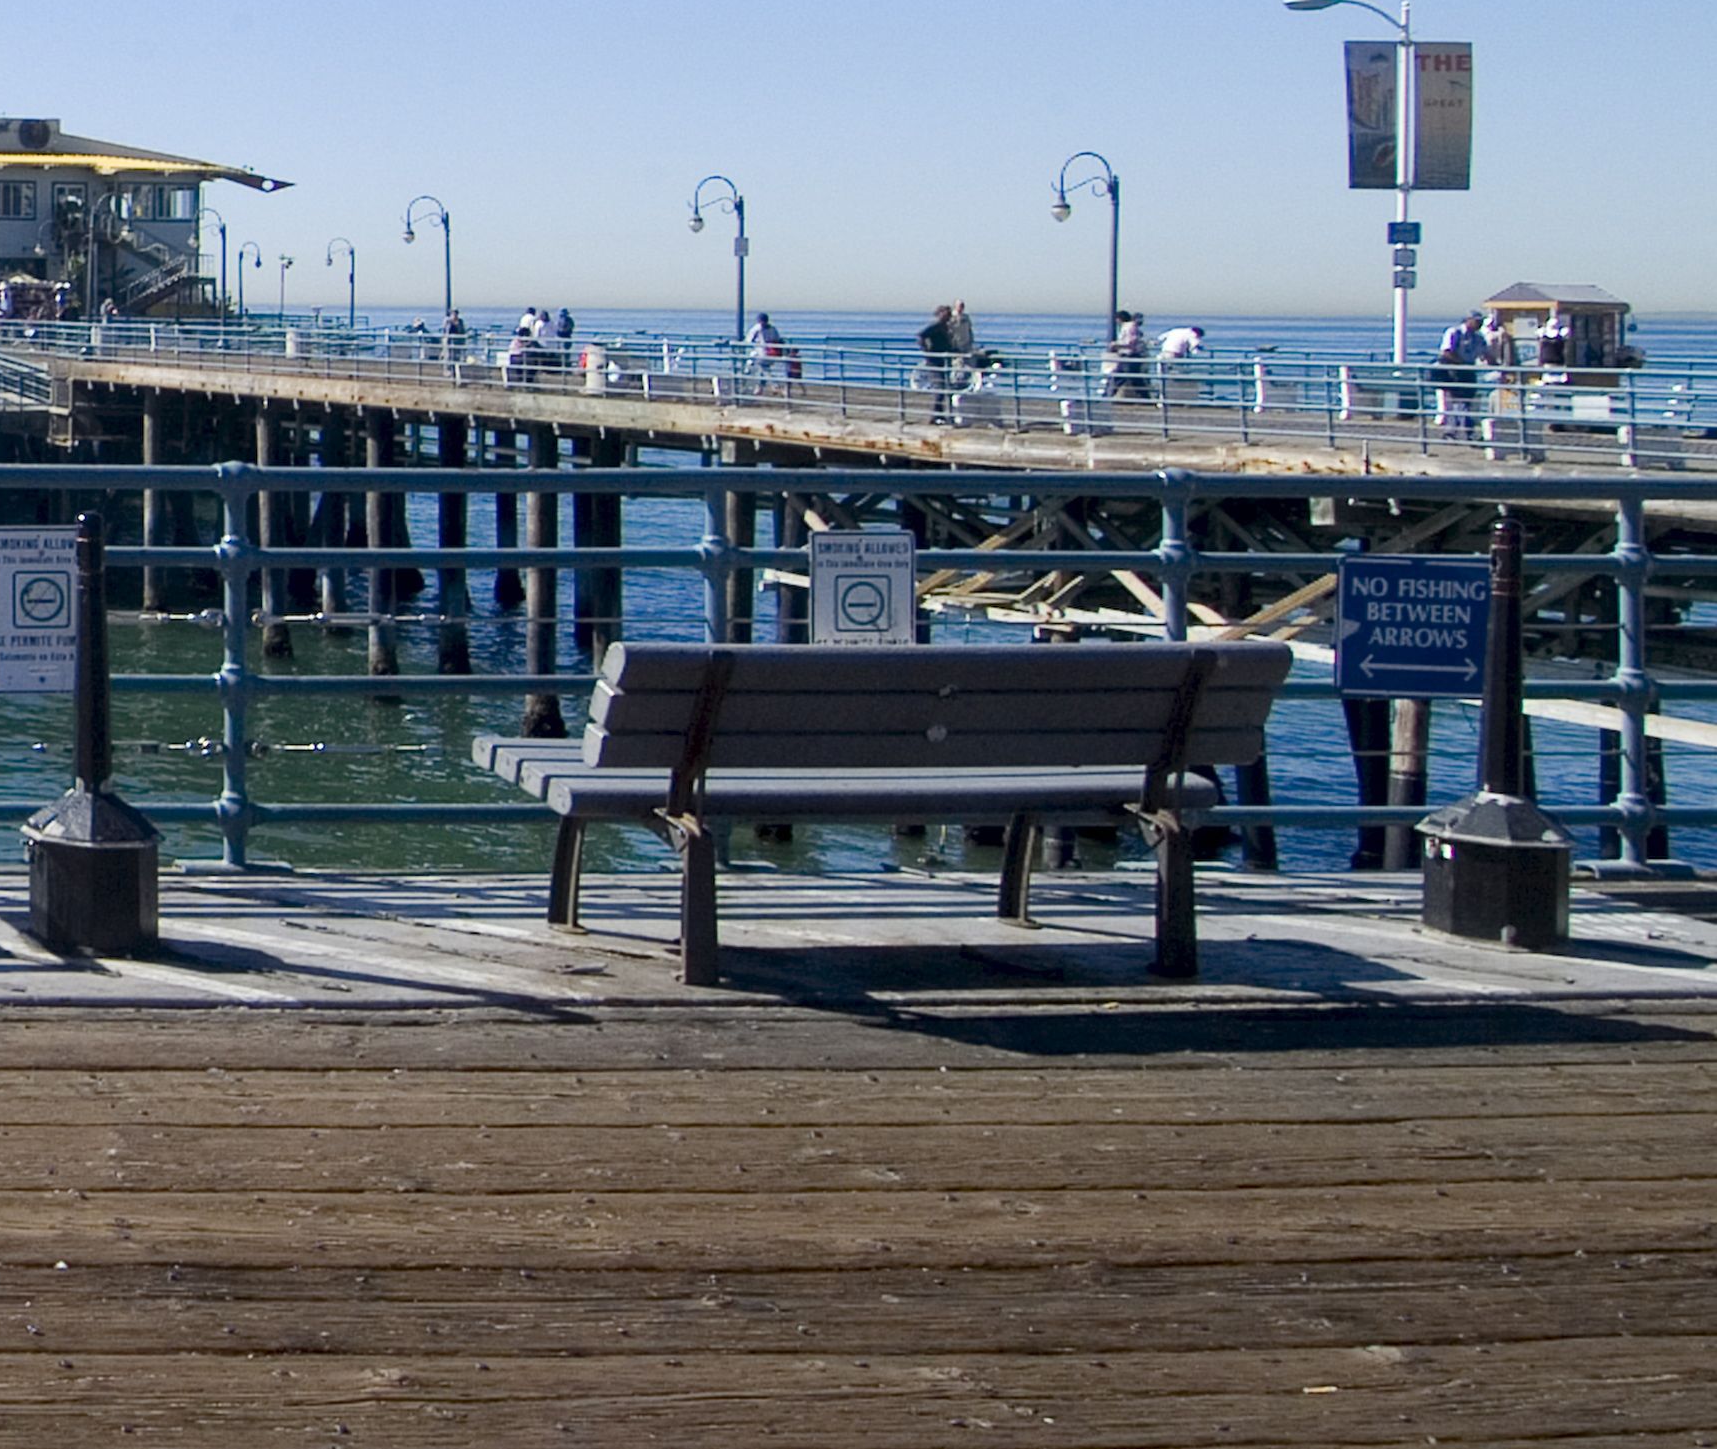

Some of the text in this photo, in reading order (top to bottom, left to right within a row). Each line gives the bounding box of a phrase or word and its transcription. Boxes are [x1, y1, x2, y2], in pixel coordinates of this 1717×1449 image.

[1415, 54, 1471, 72] THE
[43, 538, 75, 550] ALLOW
[818, 542, 910, 554] SMOKING ALLOWED
[1351, 577, 1487, 602] NO FISHING
[1366, 602, 1471, 624] BETWEEN
[10, 635, 53, 647] PERMITE
[56, 635, 77, 647] FUM
[1367, 627, 1468, 649] ARROWS
